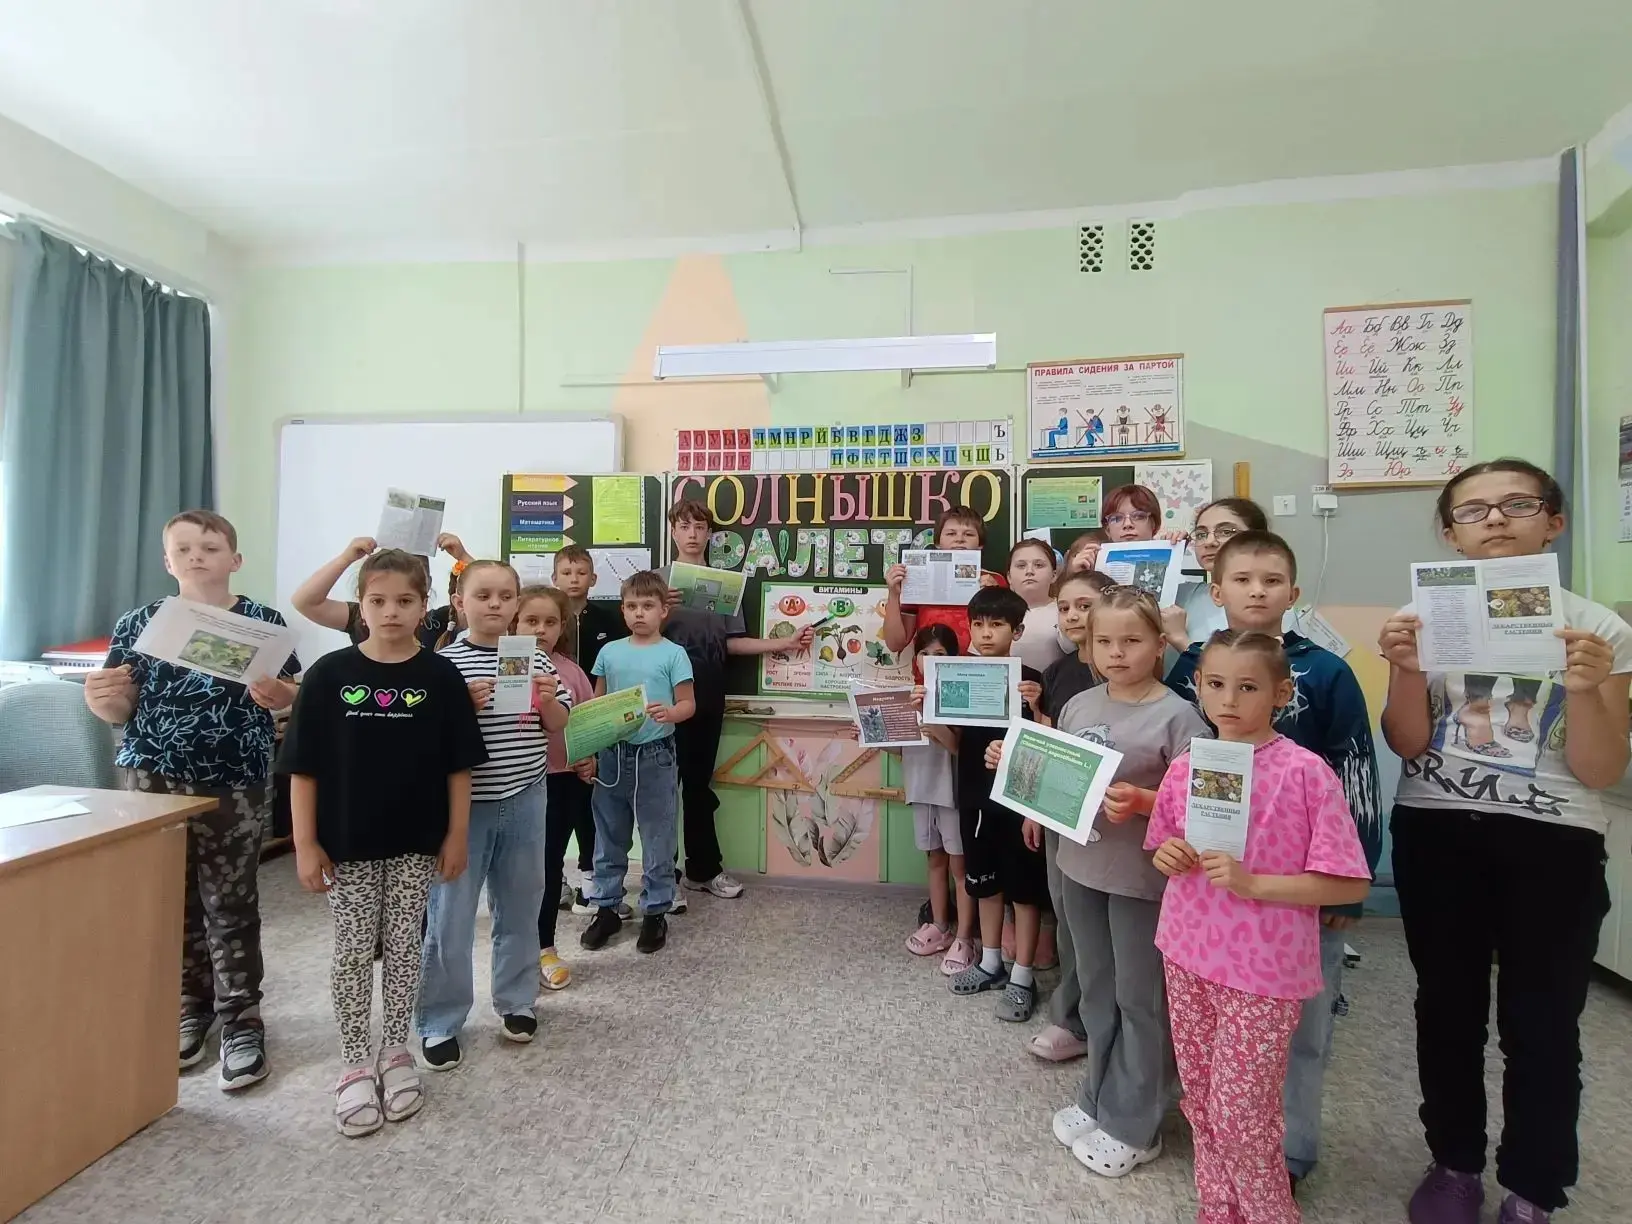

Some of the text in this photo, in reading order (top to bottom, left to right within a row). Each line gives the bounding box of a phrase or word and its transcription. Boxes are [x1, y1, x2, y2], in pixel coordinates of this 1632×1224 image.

[1034, 360, 1174, 377] ПРАВИЛА СИДЕНИЯ ЗА ПАРТОЙ
[818, 586, 863, 594] ВИТАМИНЫ
